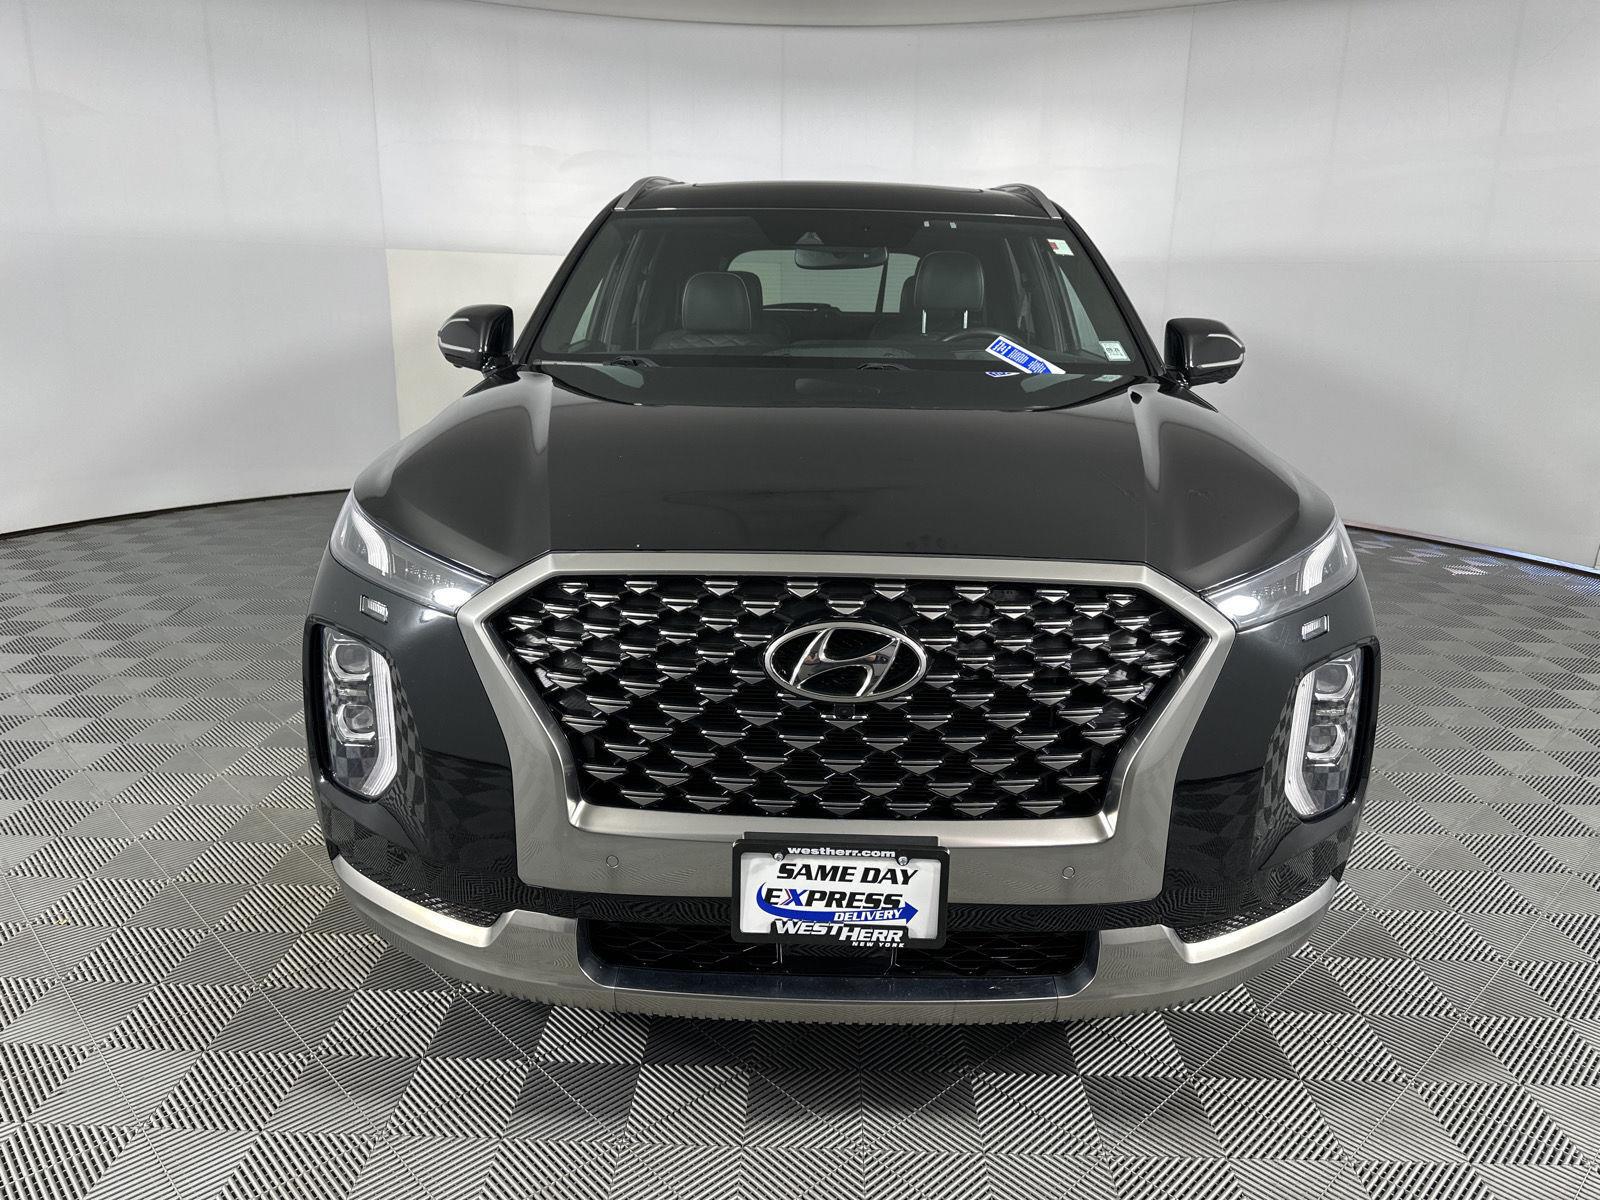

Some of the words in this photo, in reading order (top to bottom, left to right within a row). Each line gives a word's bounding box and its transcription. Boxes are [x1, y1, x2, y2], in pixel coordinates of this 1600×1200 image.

[787, 847, 896, 858] westherr.com
[776, 862, 857, 882] SAME
[860, 867, 919, 885] DAY
[764, 887, 903, 910] EXPRESS
[833, 908, 903, 921] DELIVERY
